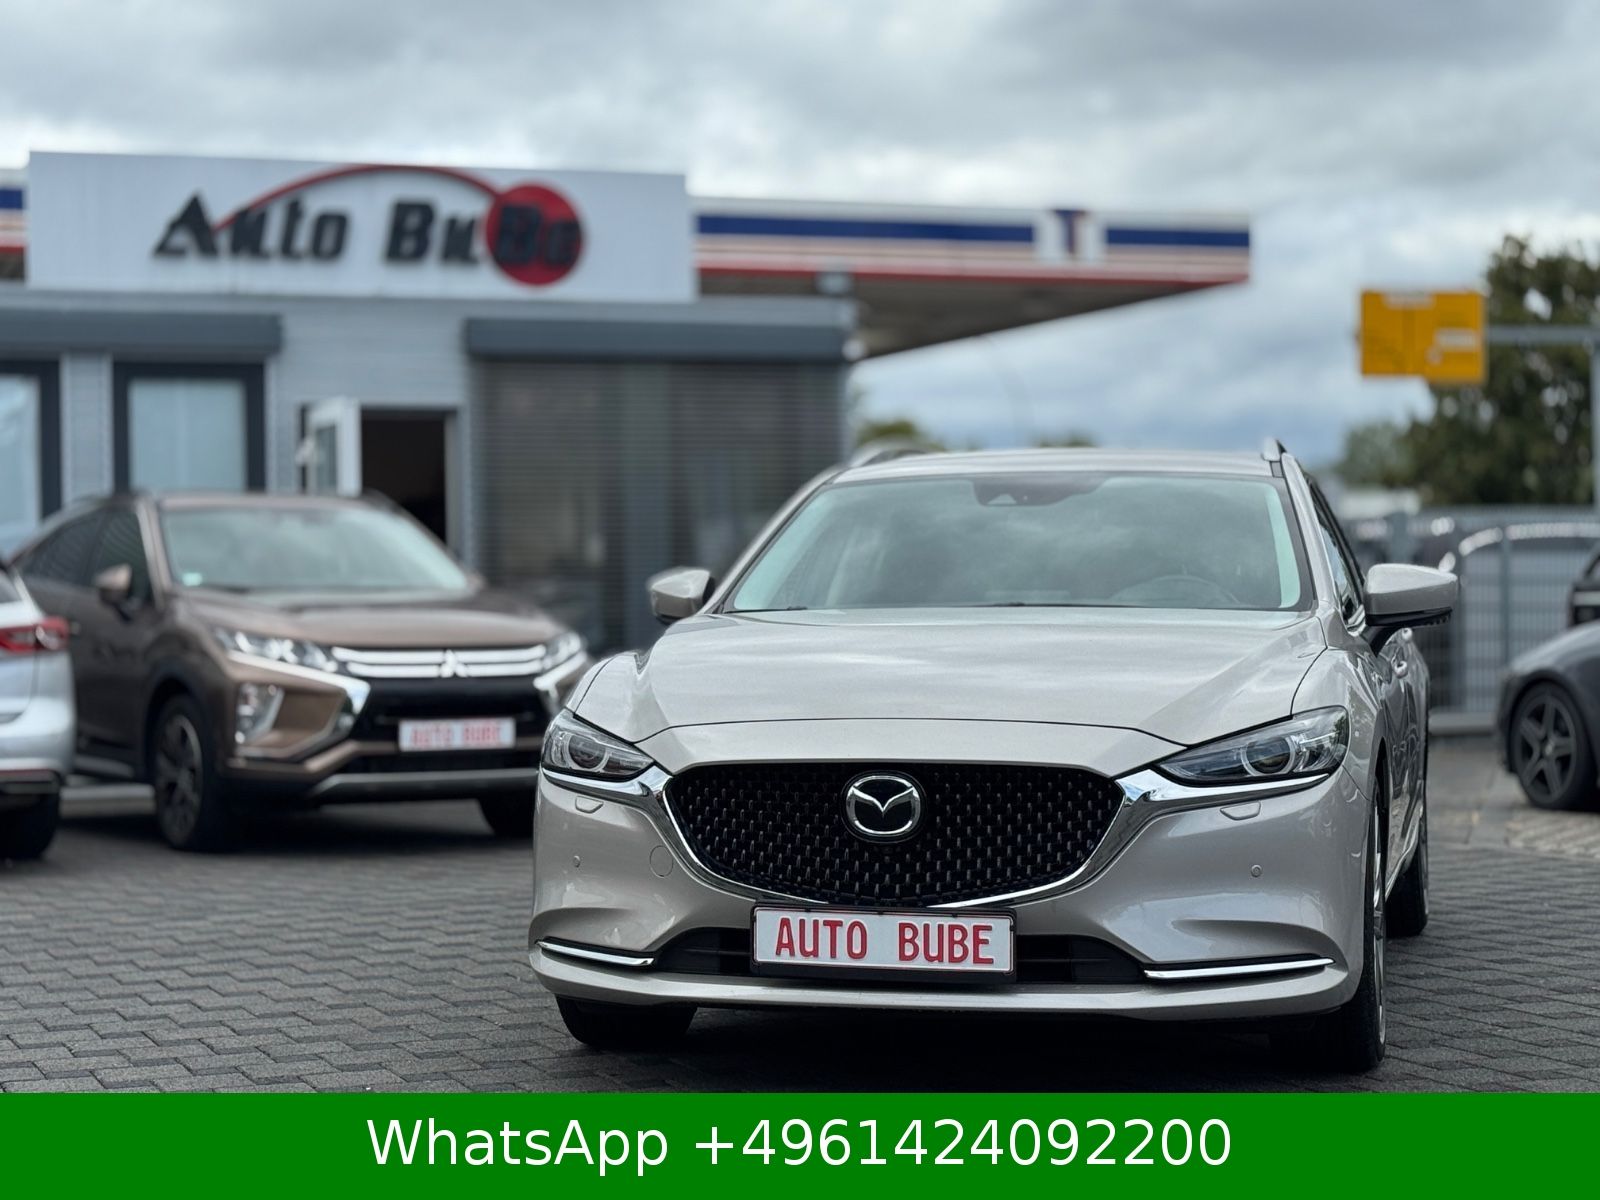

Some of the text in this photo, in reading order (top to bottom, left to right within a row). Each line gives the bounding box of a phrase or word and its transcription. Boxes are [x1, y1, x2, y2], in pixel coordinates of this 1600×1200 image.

[153, 194, 350, 261] Auto
[409, 723, 453, 747] AUTO
[775, 917, 995, 965] AUTO BUBE
